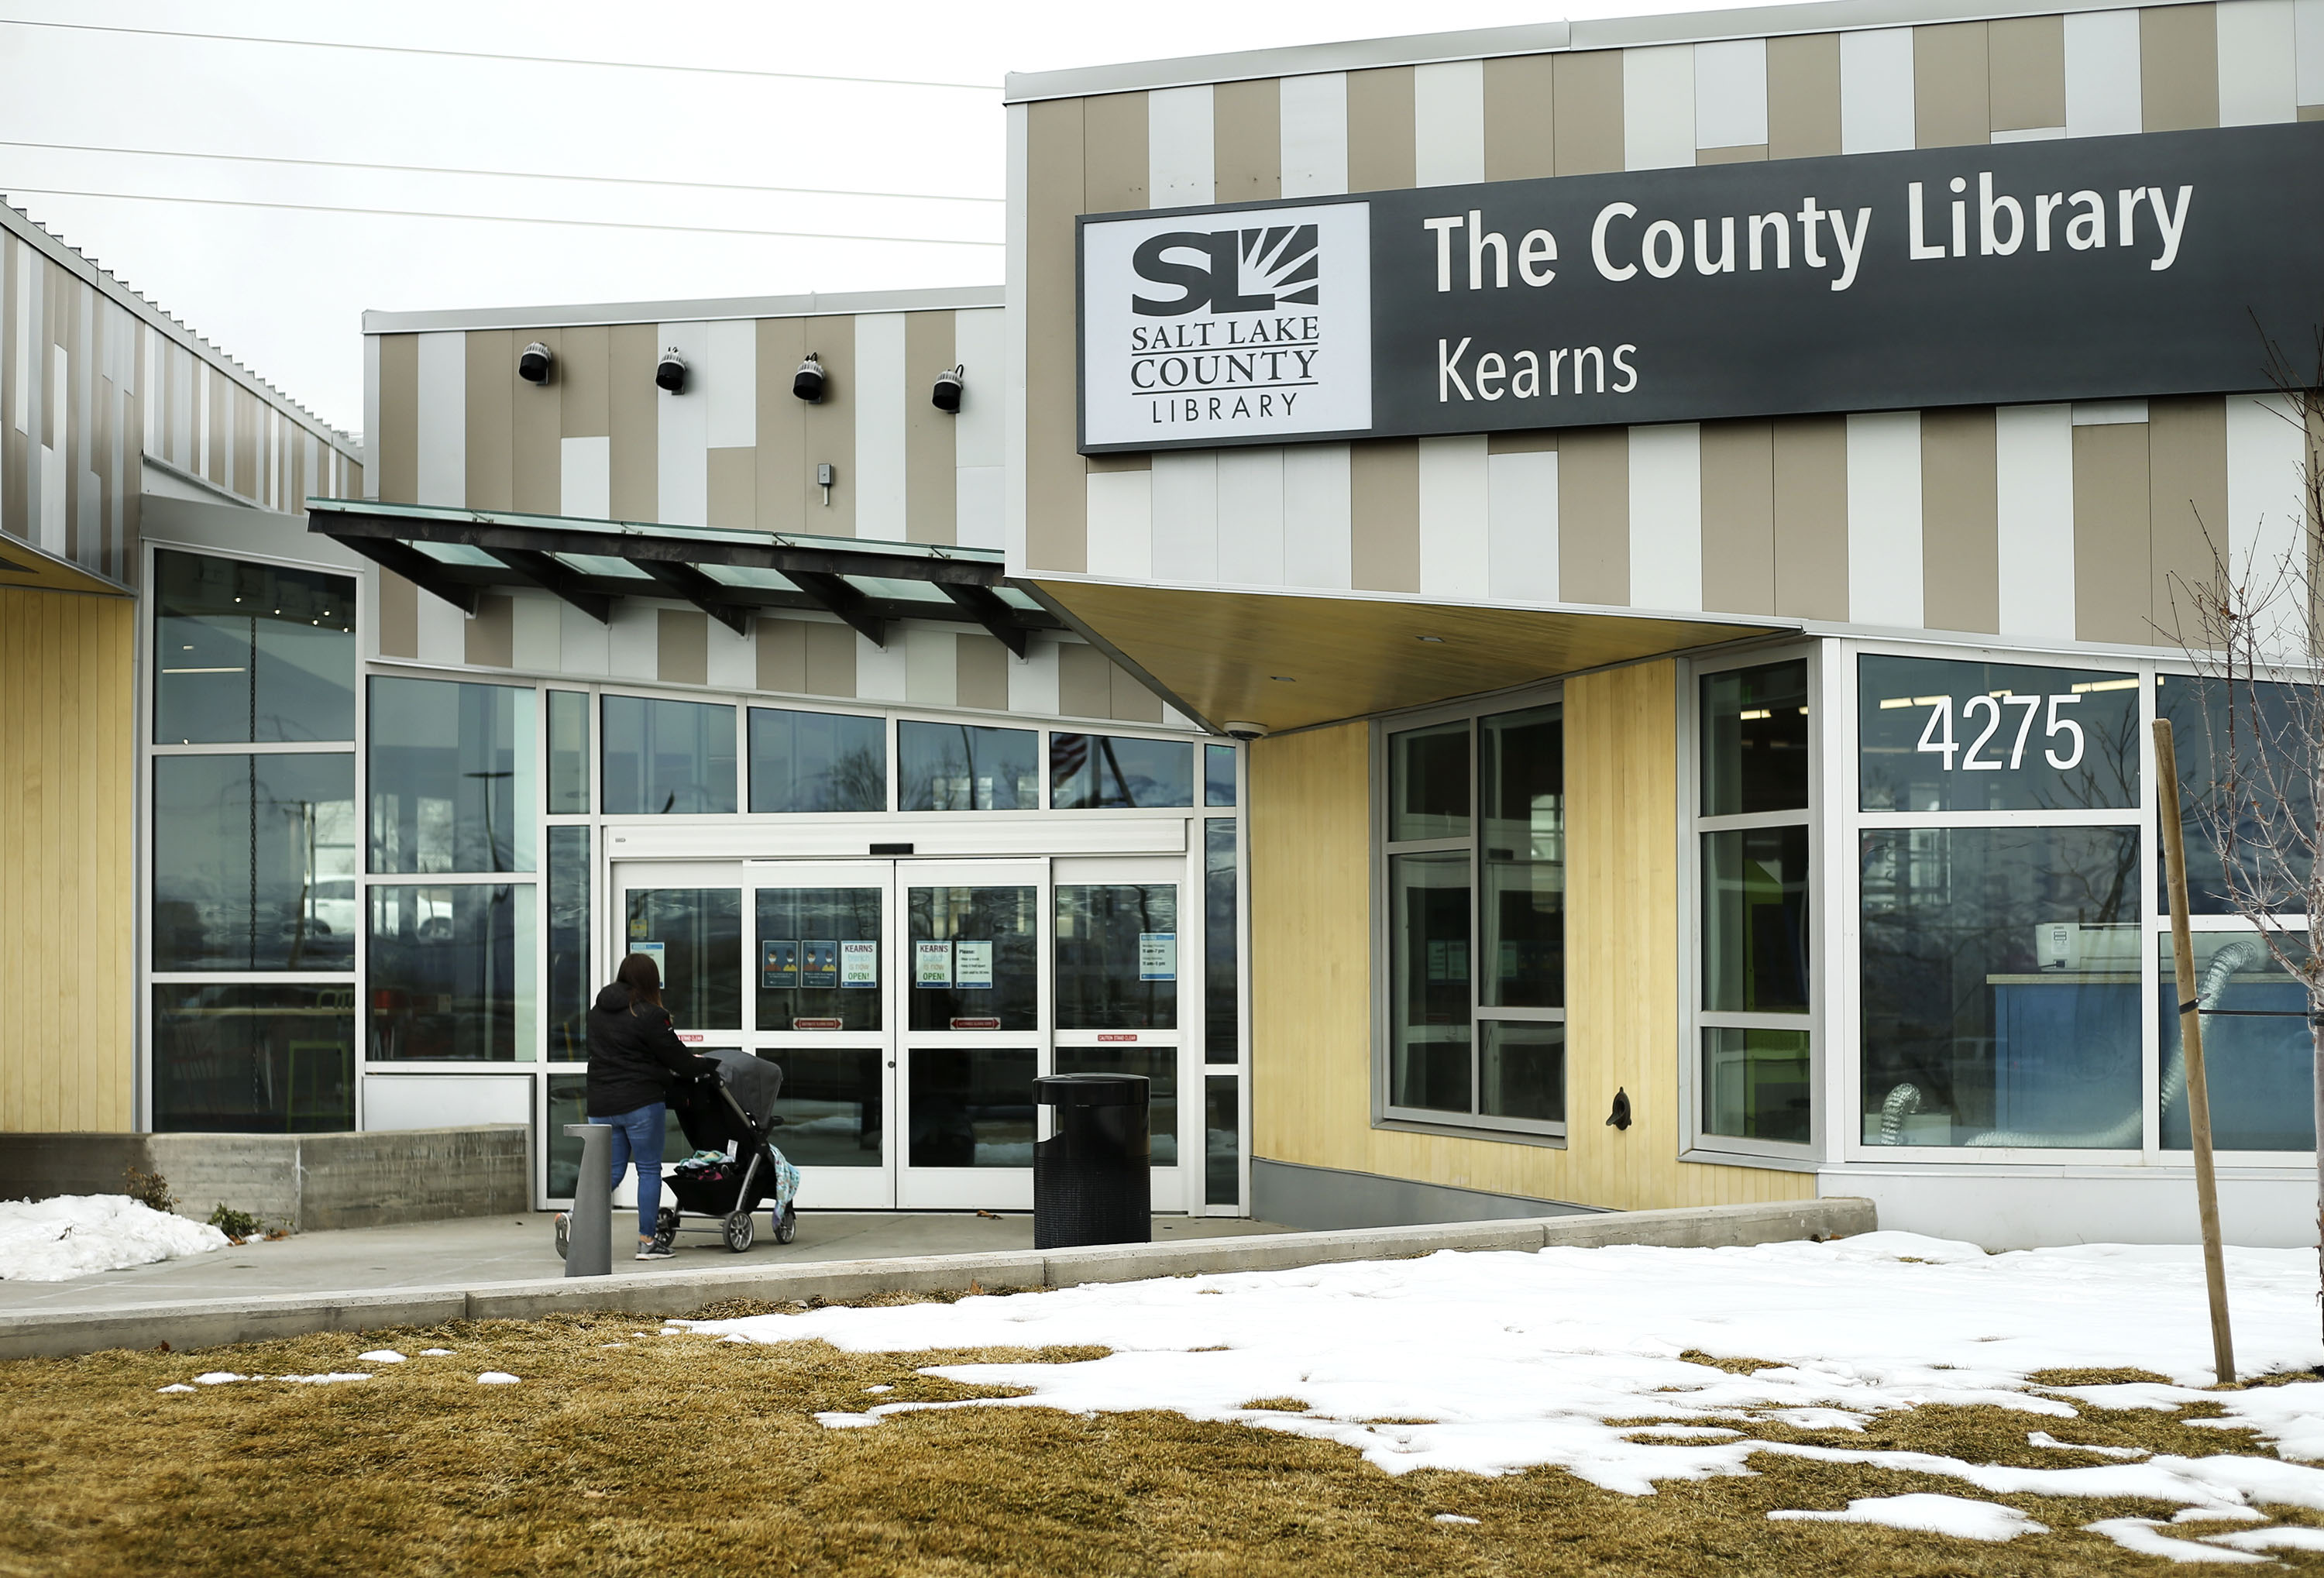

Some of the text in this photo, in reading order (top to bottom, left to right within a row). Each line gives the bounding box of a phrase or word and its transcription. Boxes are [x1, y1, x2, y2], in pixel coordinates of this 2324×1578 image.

[1424, 172, 2193, 292] The County Library
[1133, 229, 1275, 316] SL
[1132, 316, 1319, 351] SALT LAKE
[1131, 349, 1319, 388] COUNTY
[1439, 336, 1638, 403] Kearns
[1153, 392, 1298, 424] LIBRARY
[1917, 694, 2085, 771] 4275
[844, 944, 873, 953] KEARNS
[920, 944, 948, 953] KEARNS
[847, 972, 870, 981] OPEN!
[923, 972, 945, 981] OPEN!
